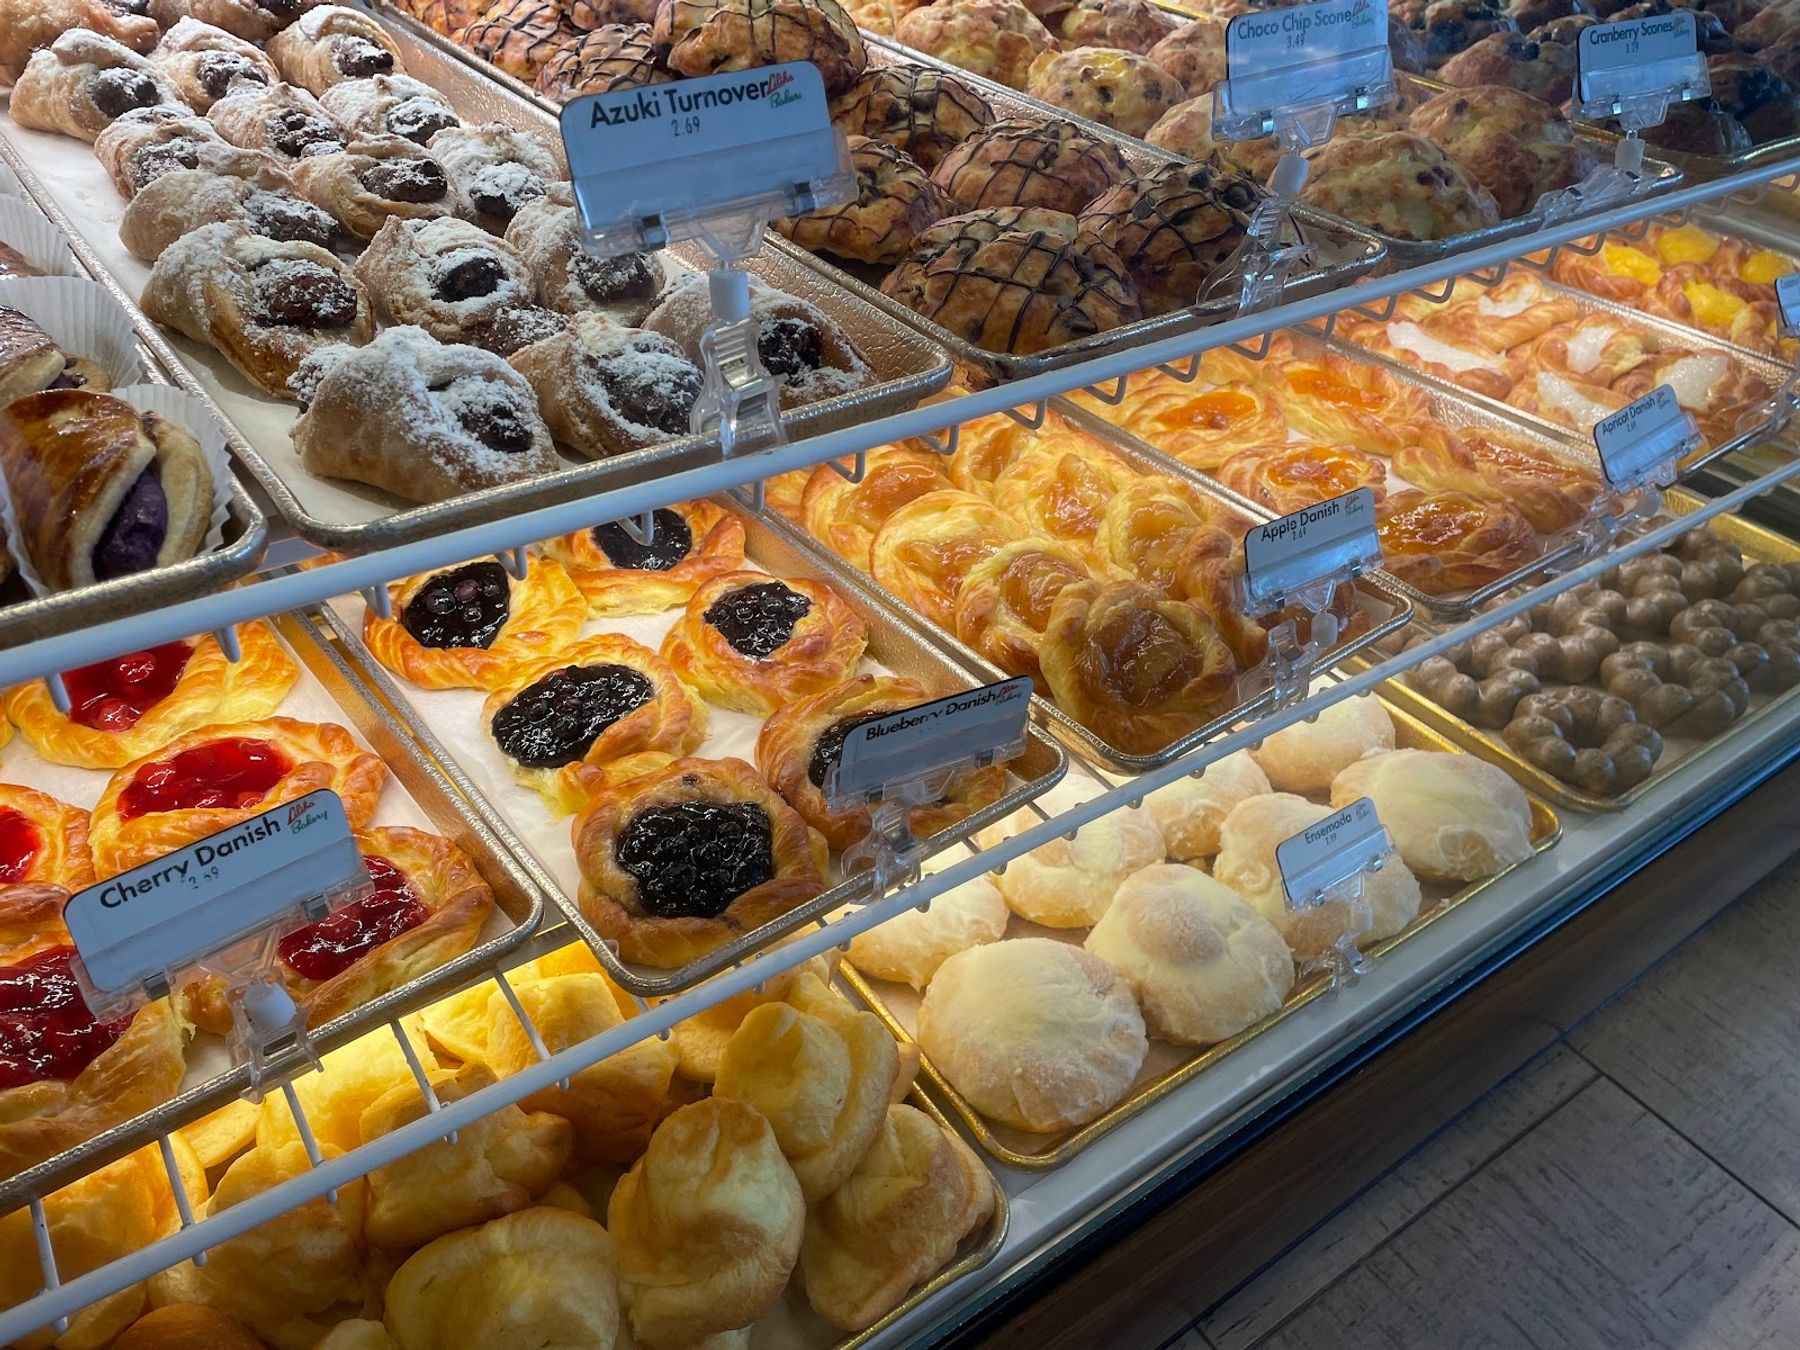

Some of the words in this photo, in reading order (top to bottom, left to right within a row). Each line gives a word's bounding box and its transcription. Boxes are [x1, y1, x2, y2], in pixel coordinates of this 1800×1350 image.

[1238, 20, 1279, 40] Choco
[1282, 12, 1312, 34] Chip
[1590, 26, 1639, 45] Cranberry
[1641, 21, 1673, 36] Scones
[590, 91, 661, 128] Azuki
[663, 80, 769, 116] Turnover
[671, 116, 701, 137] 2.69
[1602, 412, 1629, 435] Apricot
[1629, 396, 1656, 418] Danish
[1261, 519, 1297, 542] Apple
[1300, 501, 1340, 526] Danish
[866, 709, 943, 741] Blueberry
[945, 690, 996, 717] Danish
[291, 810, 328, 834] Bakery
[1304, 812, 1353, 844] Ensemada
[100, 860, 189, 909] Cherry
[194, 816, 282, 867] Danish
